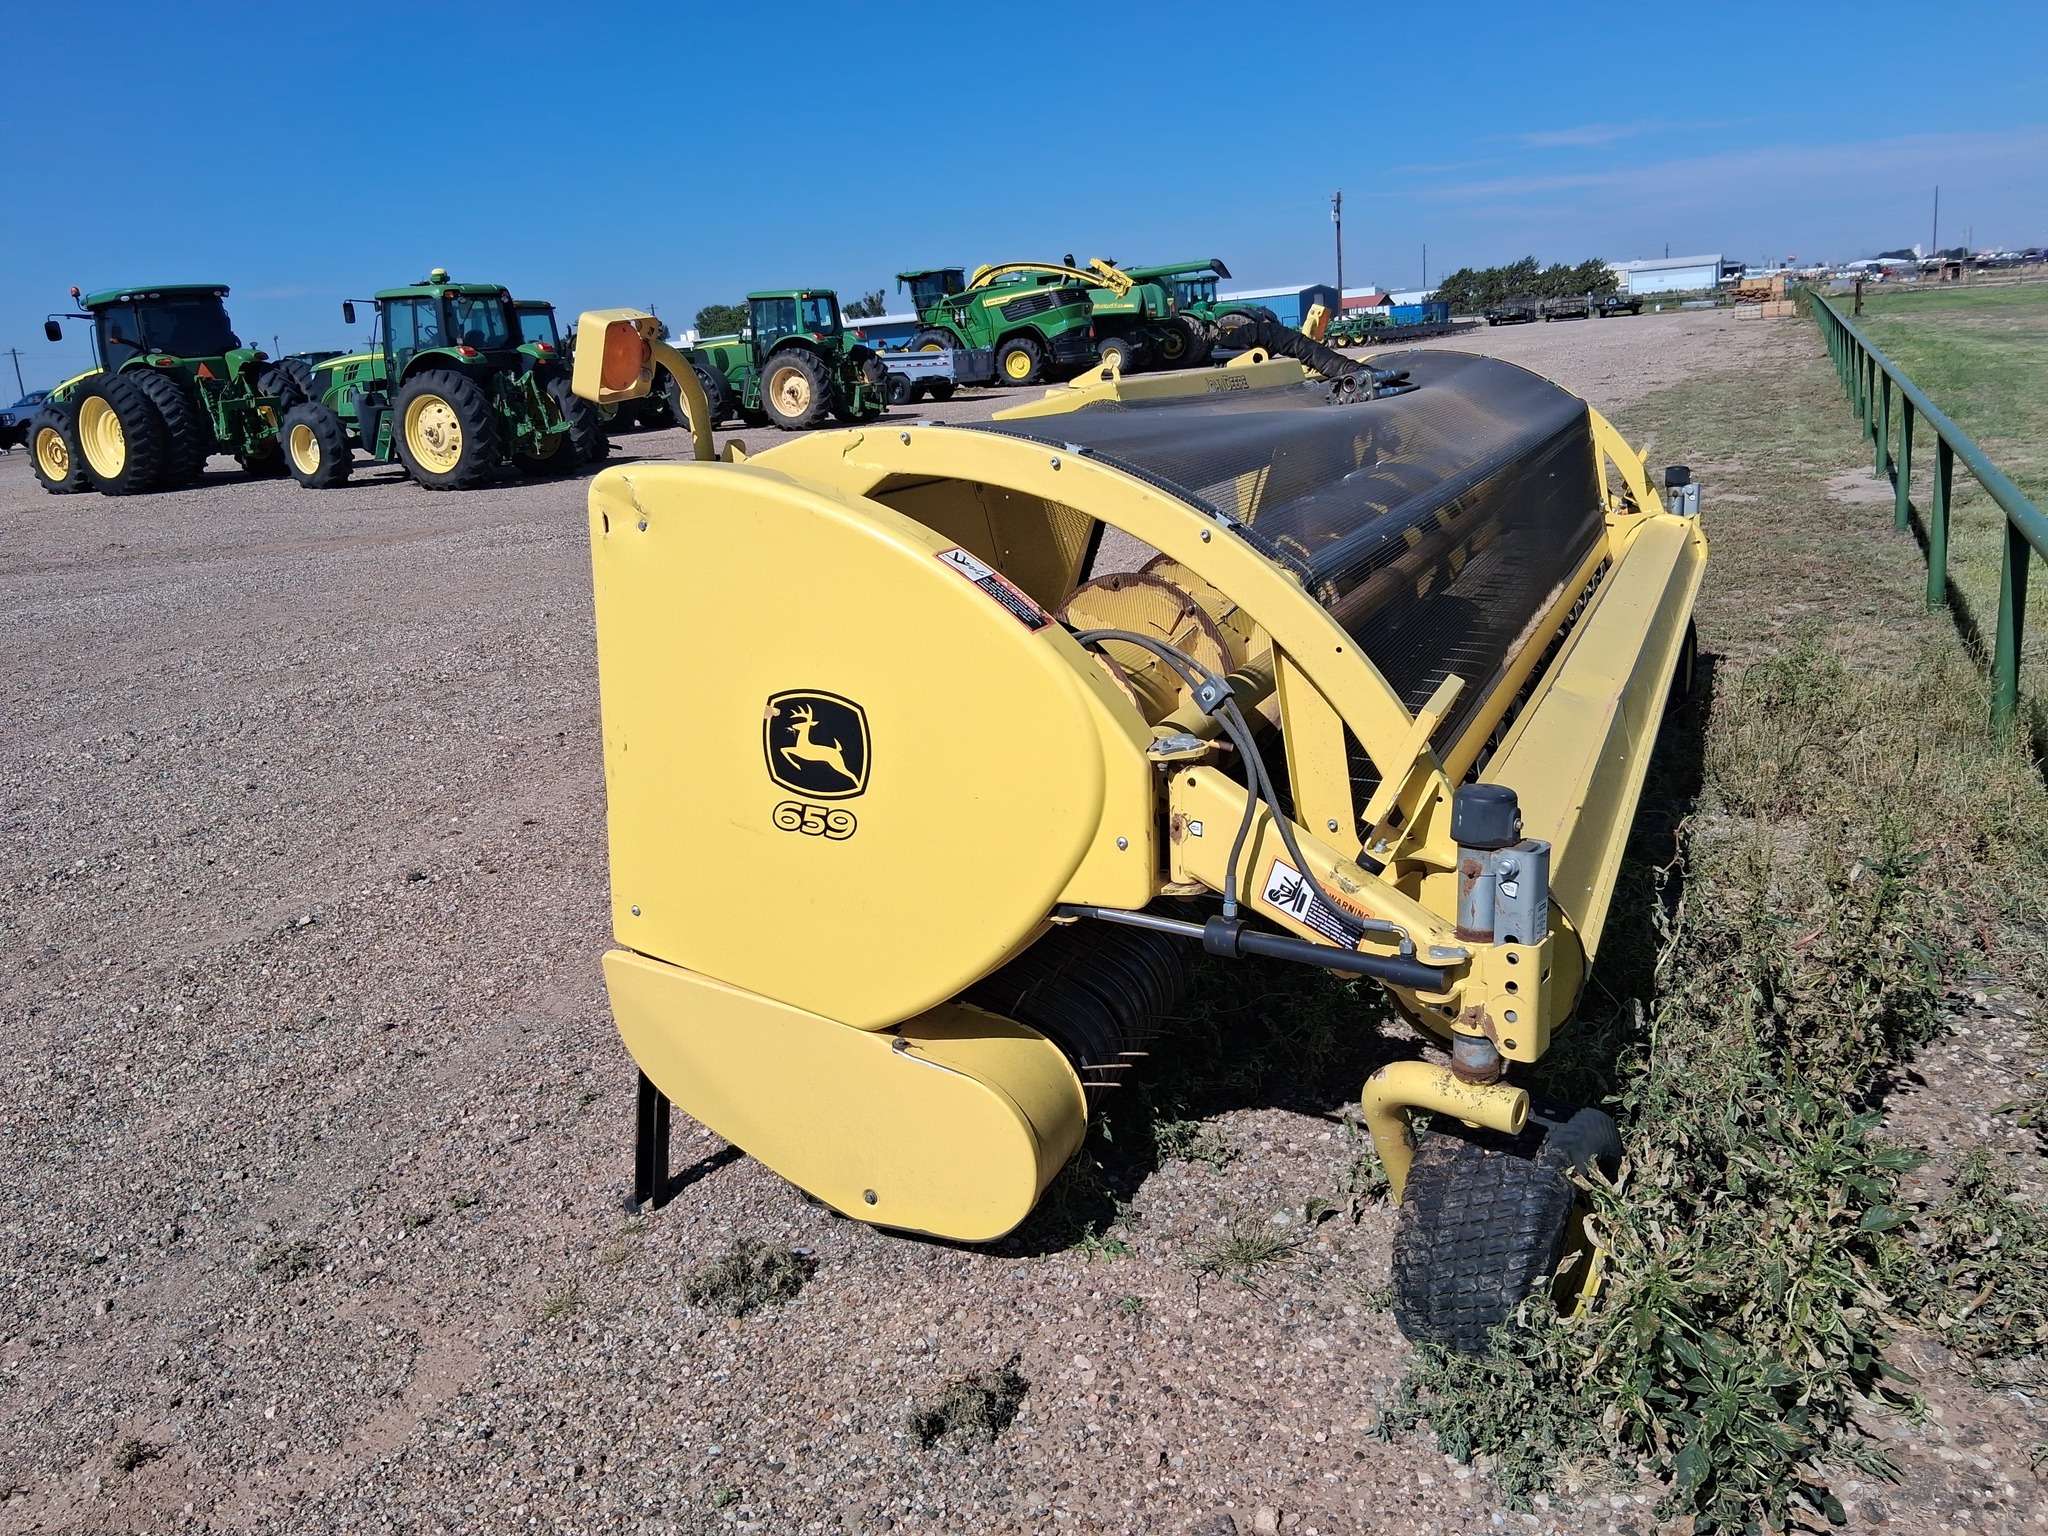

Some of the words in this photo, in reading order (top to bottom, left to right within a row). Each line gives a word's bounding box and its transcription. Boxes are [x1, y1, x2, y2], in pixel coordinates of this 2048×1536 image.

[1222, 374, 1250, 391] DEERE
[1010, 588, 1045, 617] DANGE
[772, 800, 858, 841] 659
